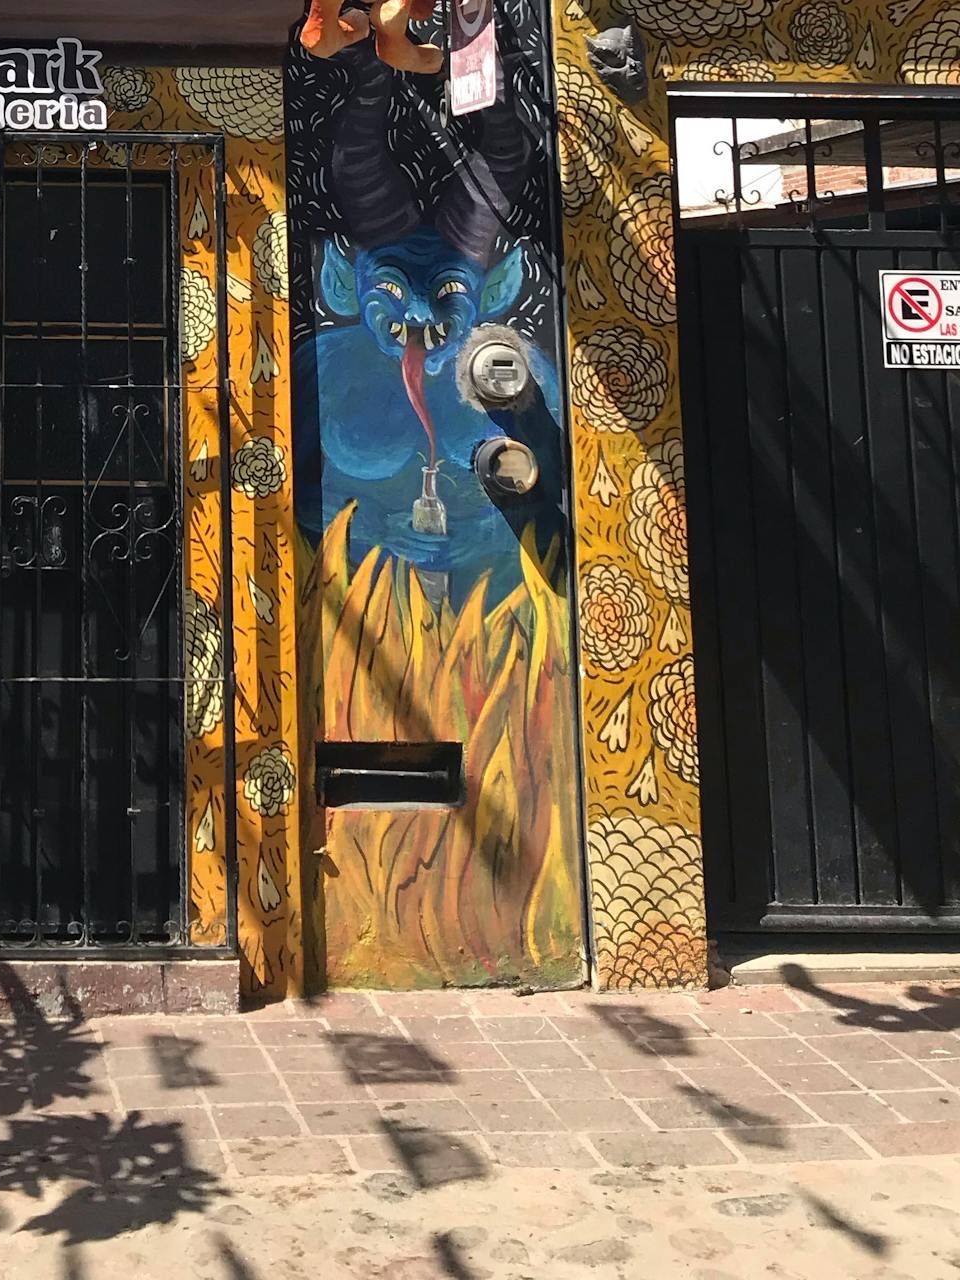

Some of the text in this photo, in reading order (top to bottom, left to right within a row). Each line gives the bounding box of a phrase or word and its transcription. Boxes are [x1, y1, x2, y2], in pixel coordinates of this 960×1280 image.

[940, 279, 960, 291] EN
[939, 324, 957, 336] LAS
[890, 344, 910, 364] NO
